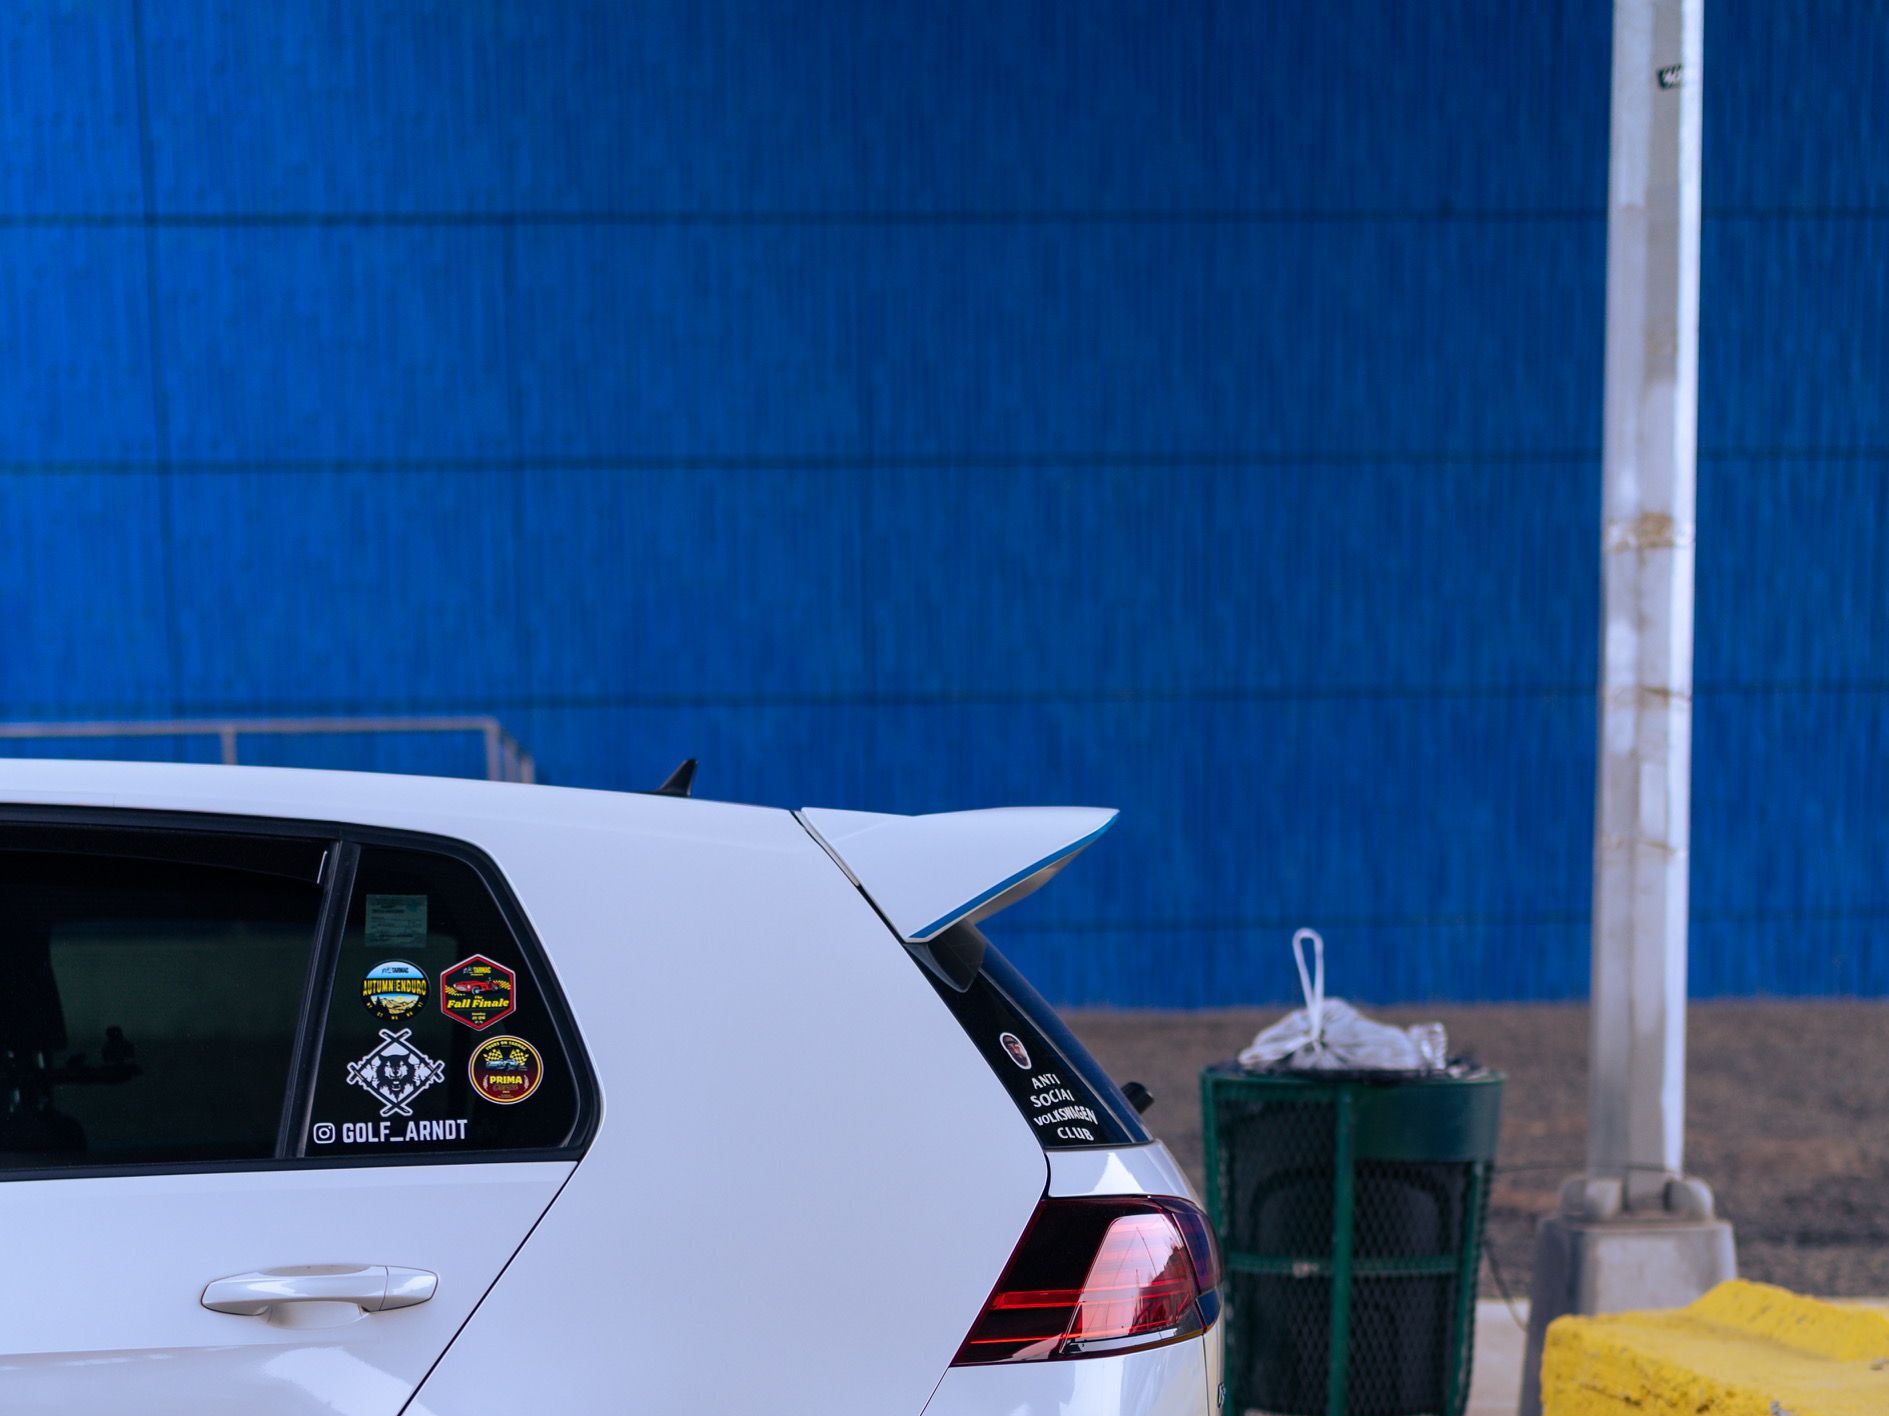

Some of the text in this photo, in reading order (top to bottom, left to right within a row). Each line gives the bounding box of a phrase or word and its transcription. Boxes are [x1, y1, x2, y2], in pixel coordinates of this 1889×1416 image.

[362, 979, 427, 996] AUTUMN ENDURO
[446, 998, 510, 1008] Fall Finale
[489, 1075, 523, 1084] PRIMA
[1031, 1073, 1061, 1089] ANTI
[1030, 1088, 1075, 1108] SOCIAL
[1033, 1105, 1099, 1126] VOLKSWAGEN
[342, 1119, 468, 1144] GOLF_ARNDT
[1057, 1126, 1094, 1141] CLUB
